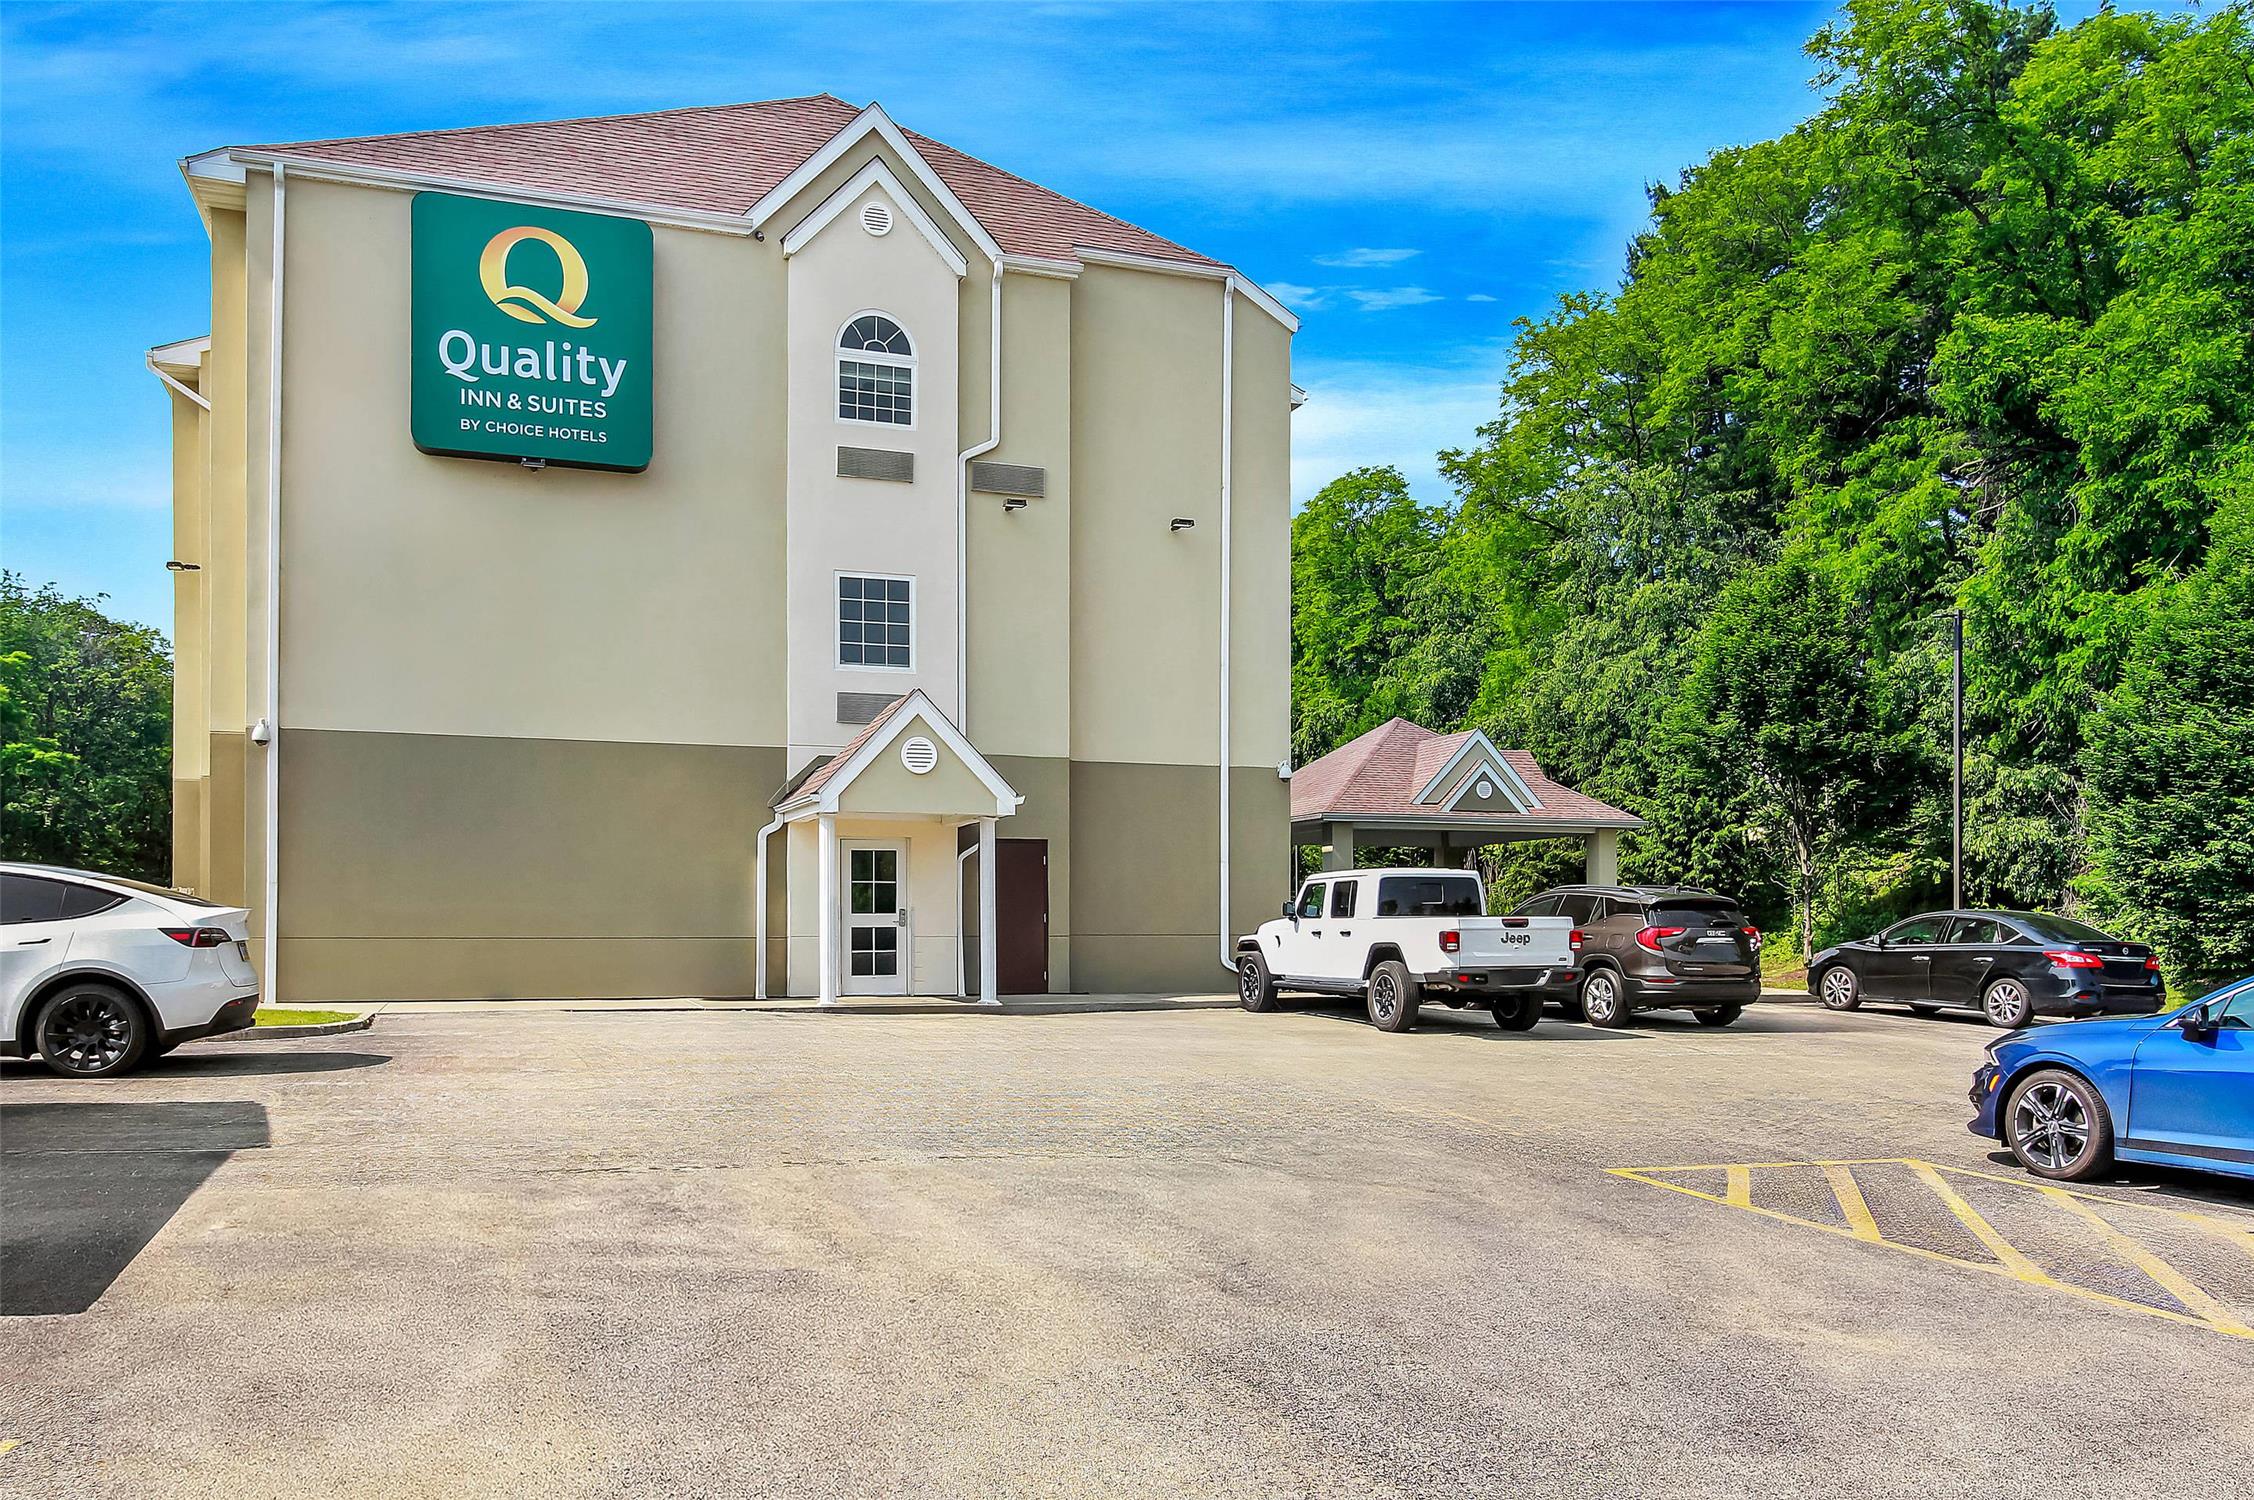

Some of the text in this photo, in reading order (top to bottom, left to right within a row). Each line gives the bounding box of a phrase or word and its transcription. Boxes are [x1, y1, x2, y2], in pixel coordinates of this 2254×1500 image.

[479, 226, 598, 328] Q
[438, 329, 627, 397] Quality
[460, 388, 608, 418] INN & SUITES
[460, 418, 607, 443] BY CHOICE HOTELS
[1500, 931, 1531, 945] Jeep
